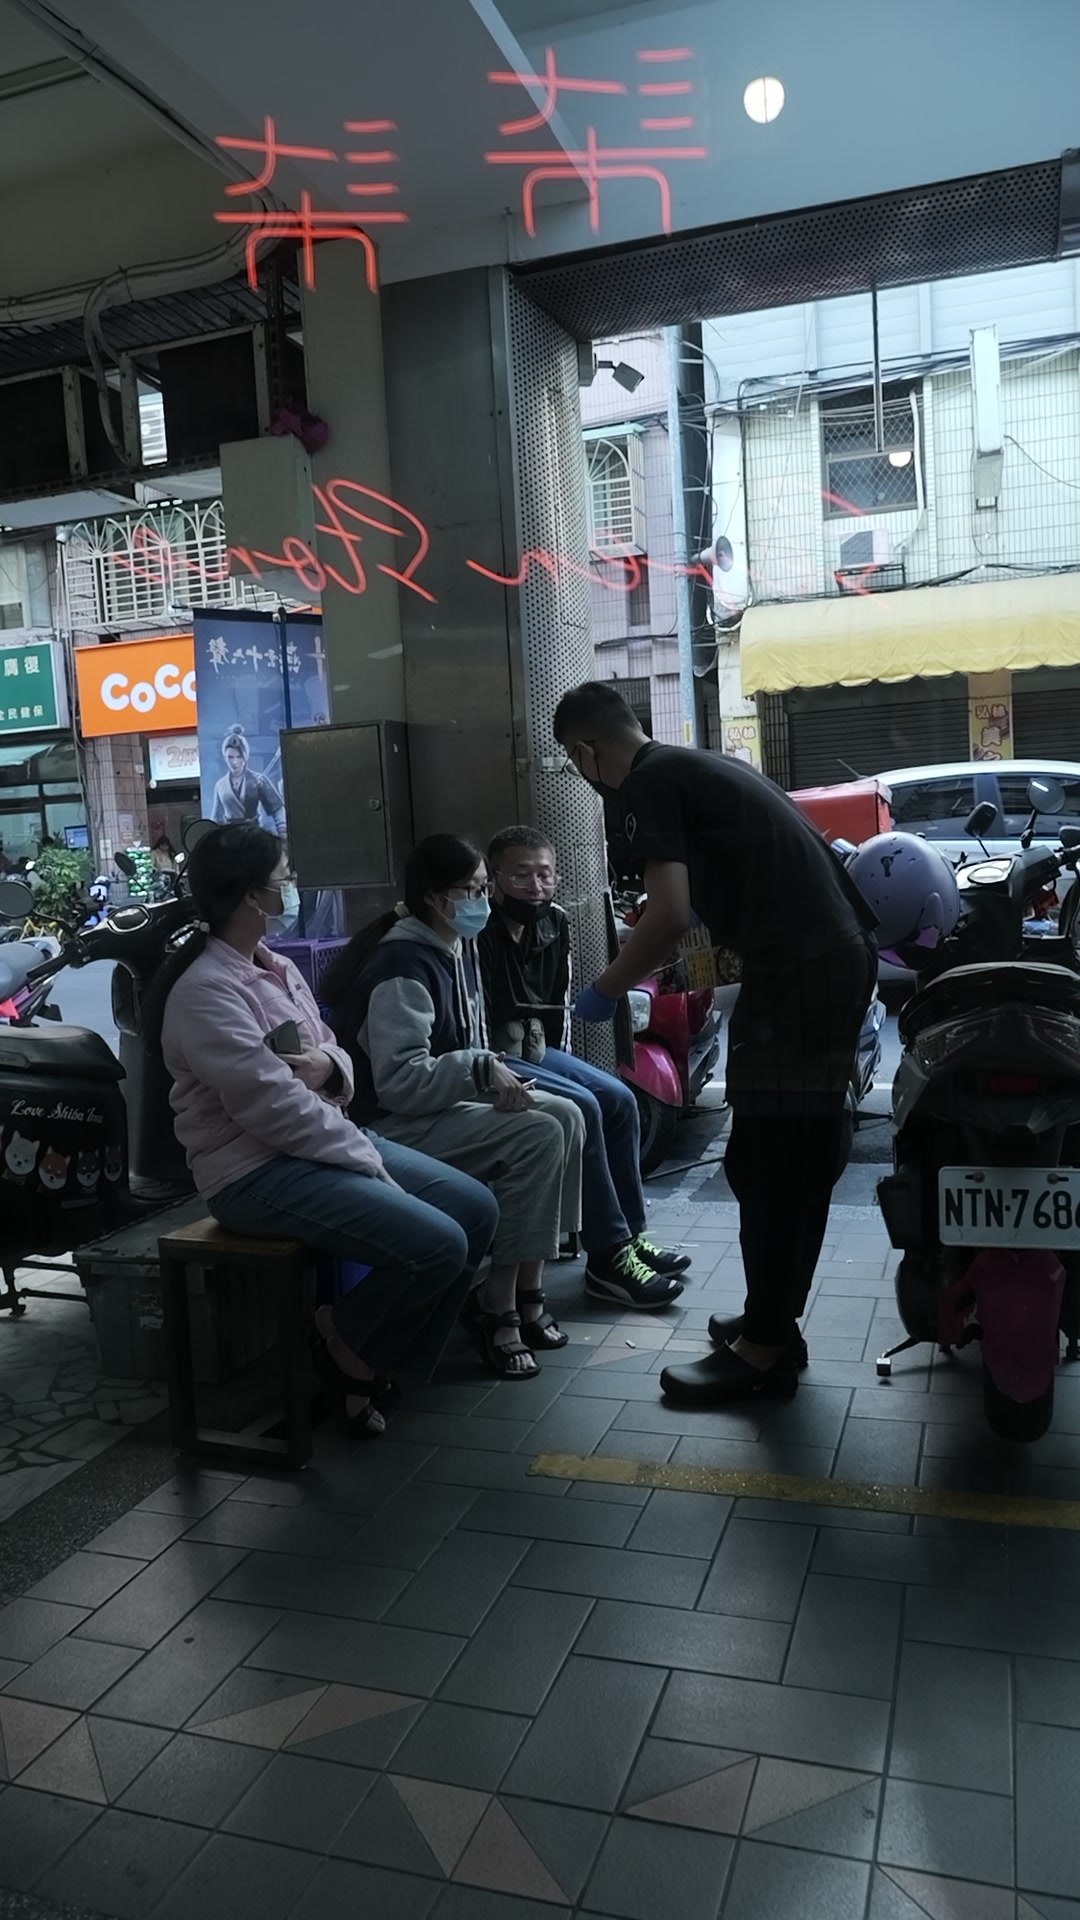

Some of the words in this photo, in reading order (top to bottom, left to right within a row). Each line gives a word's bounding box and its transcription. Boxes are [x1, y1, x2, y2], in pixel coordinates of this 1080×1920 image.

[100, 663, 197, 713] CoCo
[10, 1099, 45, 1117] Love
[47, 1101, 85, 1122] Shiba
[86, 1107, 104, 1124] Inu
[945, 1187, 1080, 1230] NTN-768
